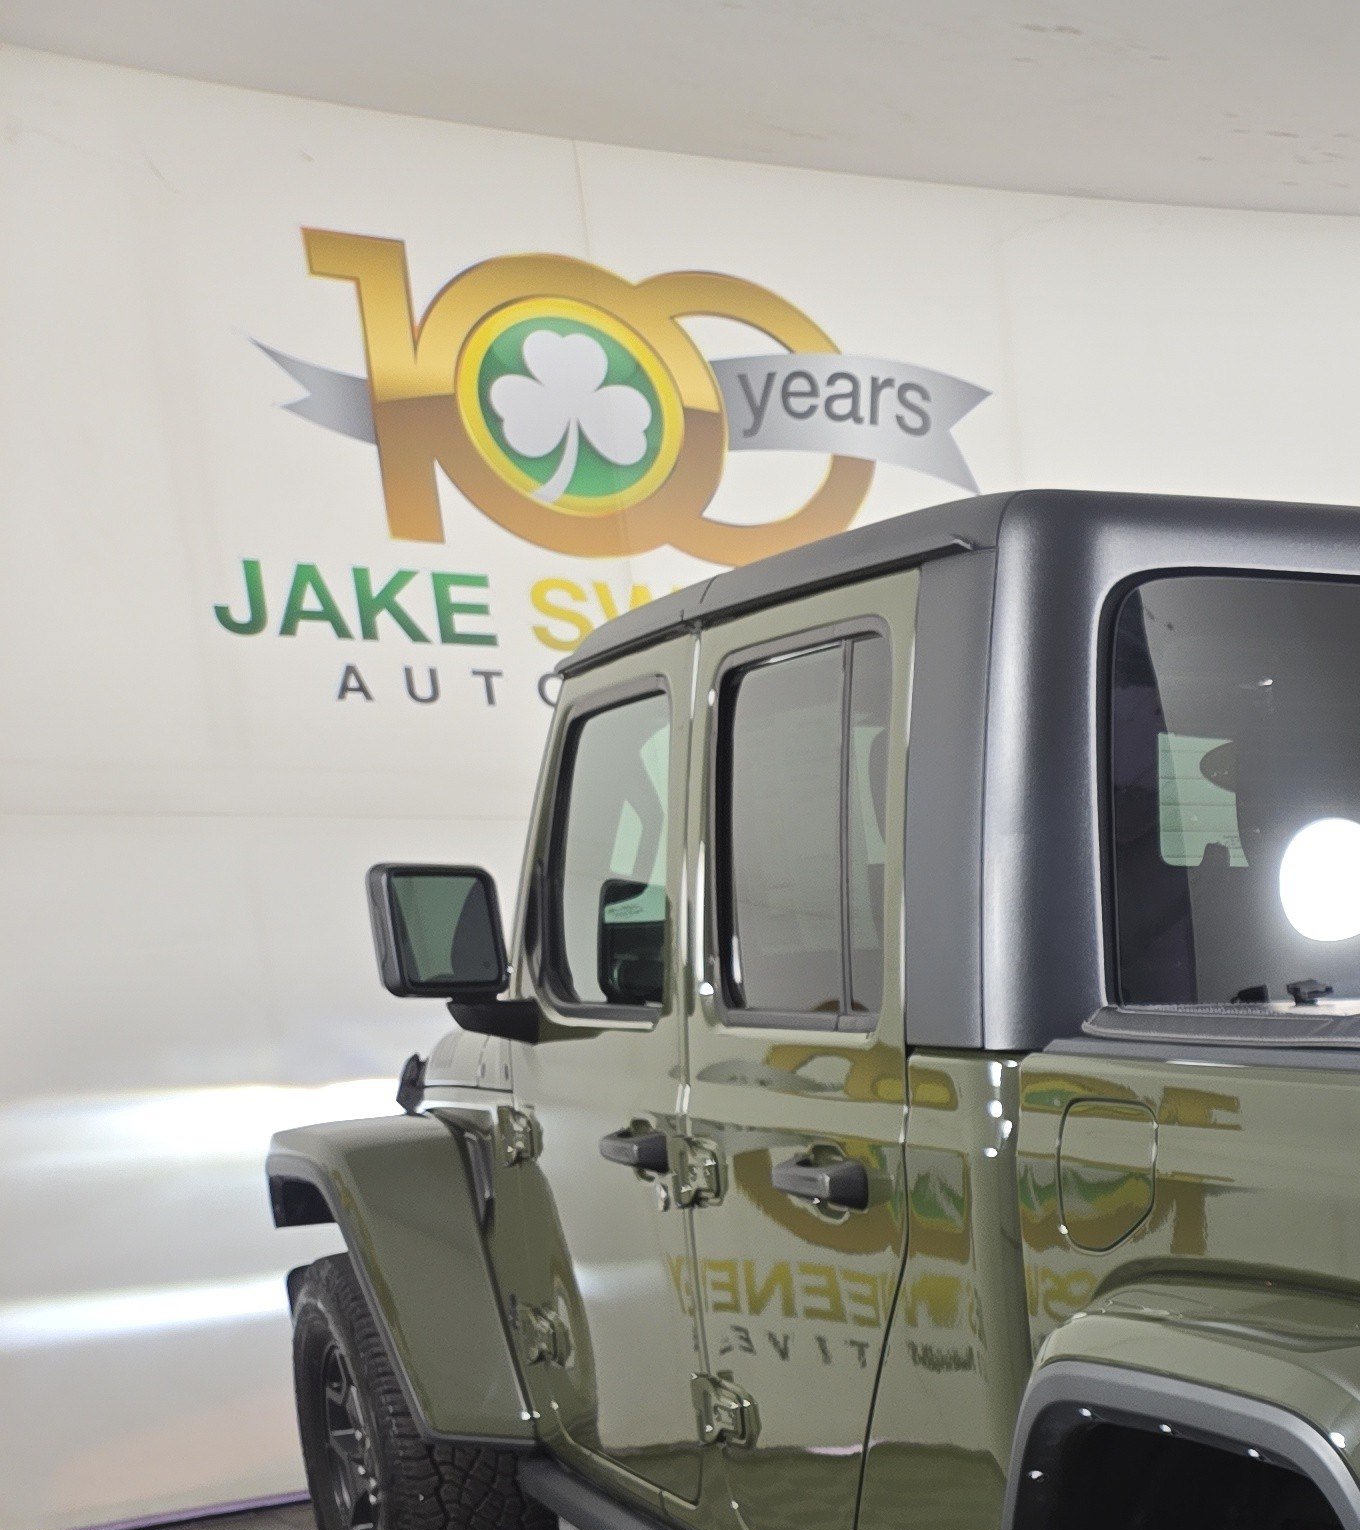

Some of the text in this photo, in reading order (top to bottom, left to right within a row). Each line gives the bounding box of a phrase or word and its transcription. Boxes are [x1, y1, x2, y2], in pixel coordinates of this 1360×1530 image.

[301, 226, 933, 566] 100 years
[213, 558, 499, 647] JAKE
